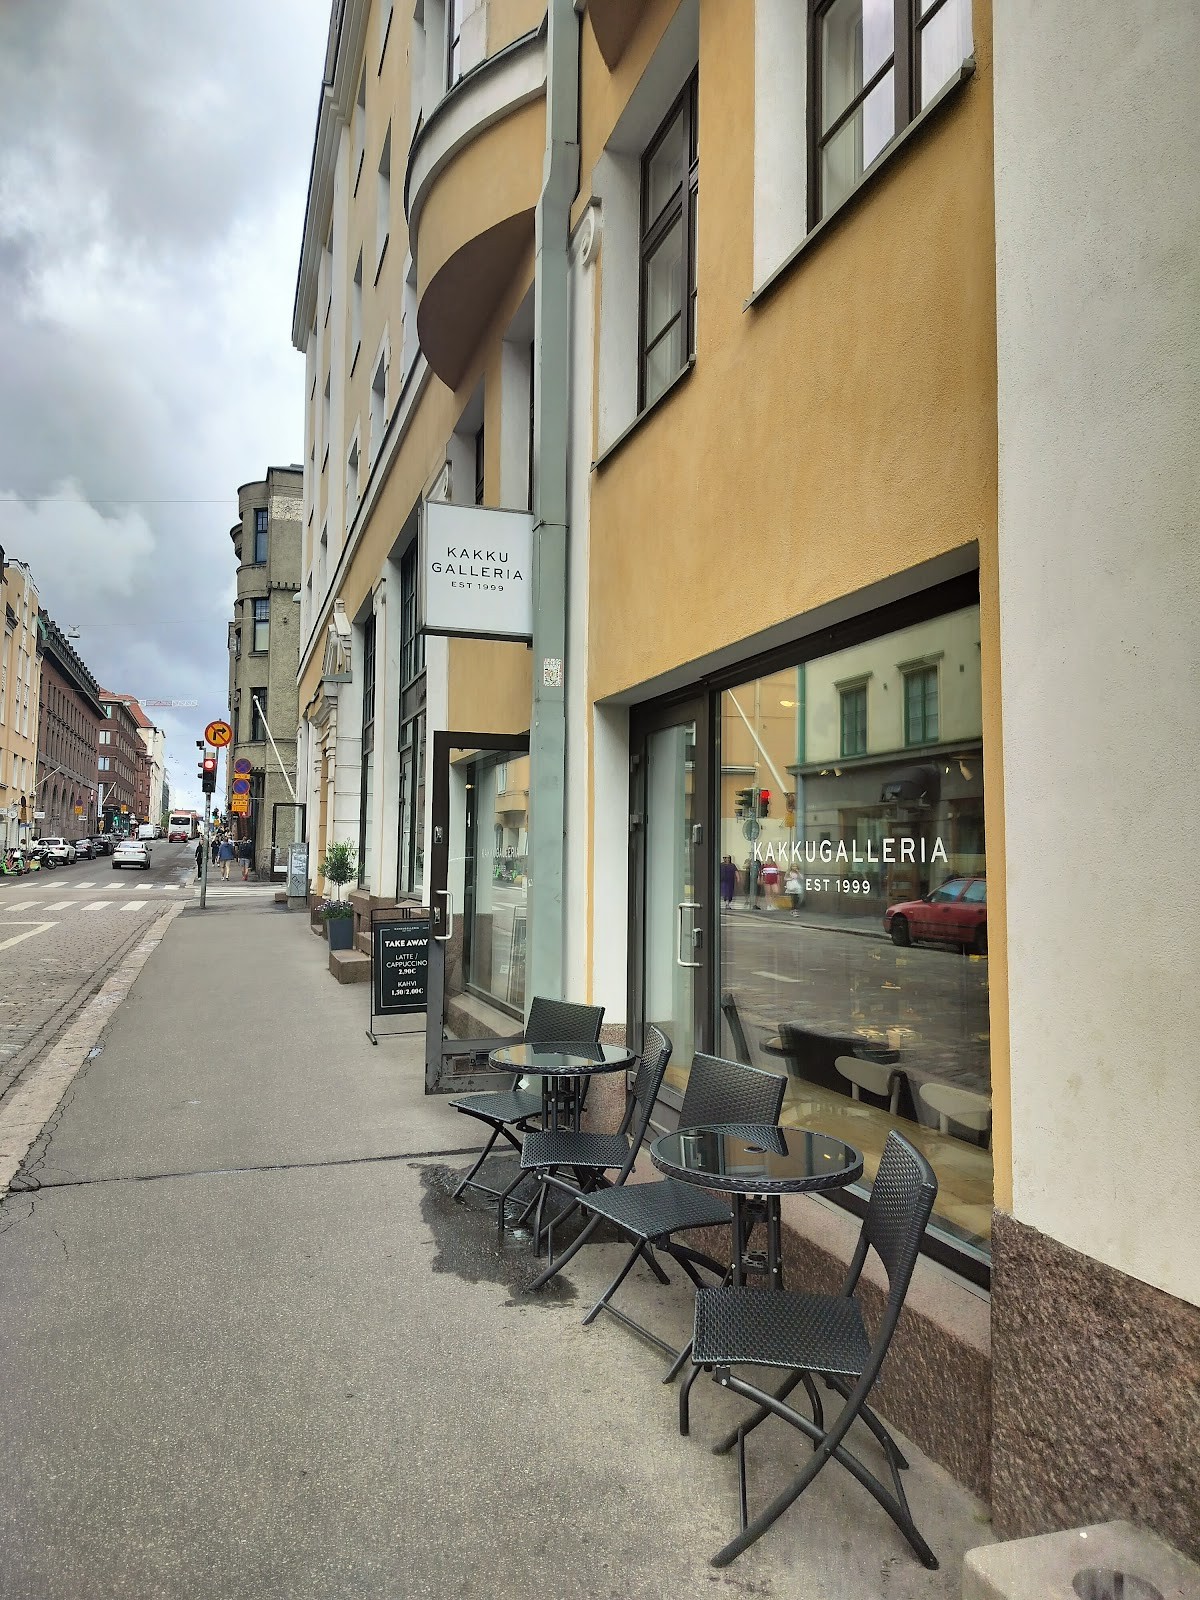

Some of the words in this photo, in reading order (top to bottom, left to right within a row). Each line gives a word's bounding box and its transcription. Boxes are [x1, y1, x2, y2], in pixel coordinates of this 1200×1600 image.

[447, 547, 508, 563] KAKKU
[431, 562, 523, 581] GALLERIA
[451, 581, 473, 589] EST
[477, 583, 504, 592] 1999
[753, 836, 949, 863] KAKKUGALLERIA
[805, 878, 831, 892] EST
[835, 879, 871, 894] 1999
[406, 939, 428, 947] AWAY
[386, 960, 428, 968] CAPPUCCINO
